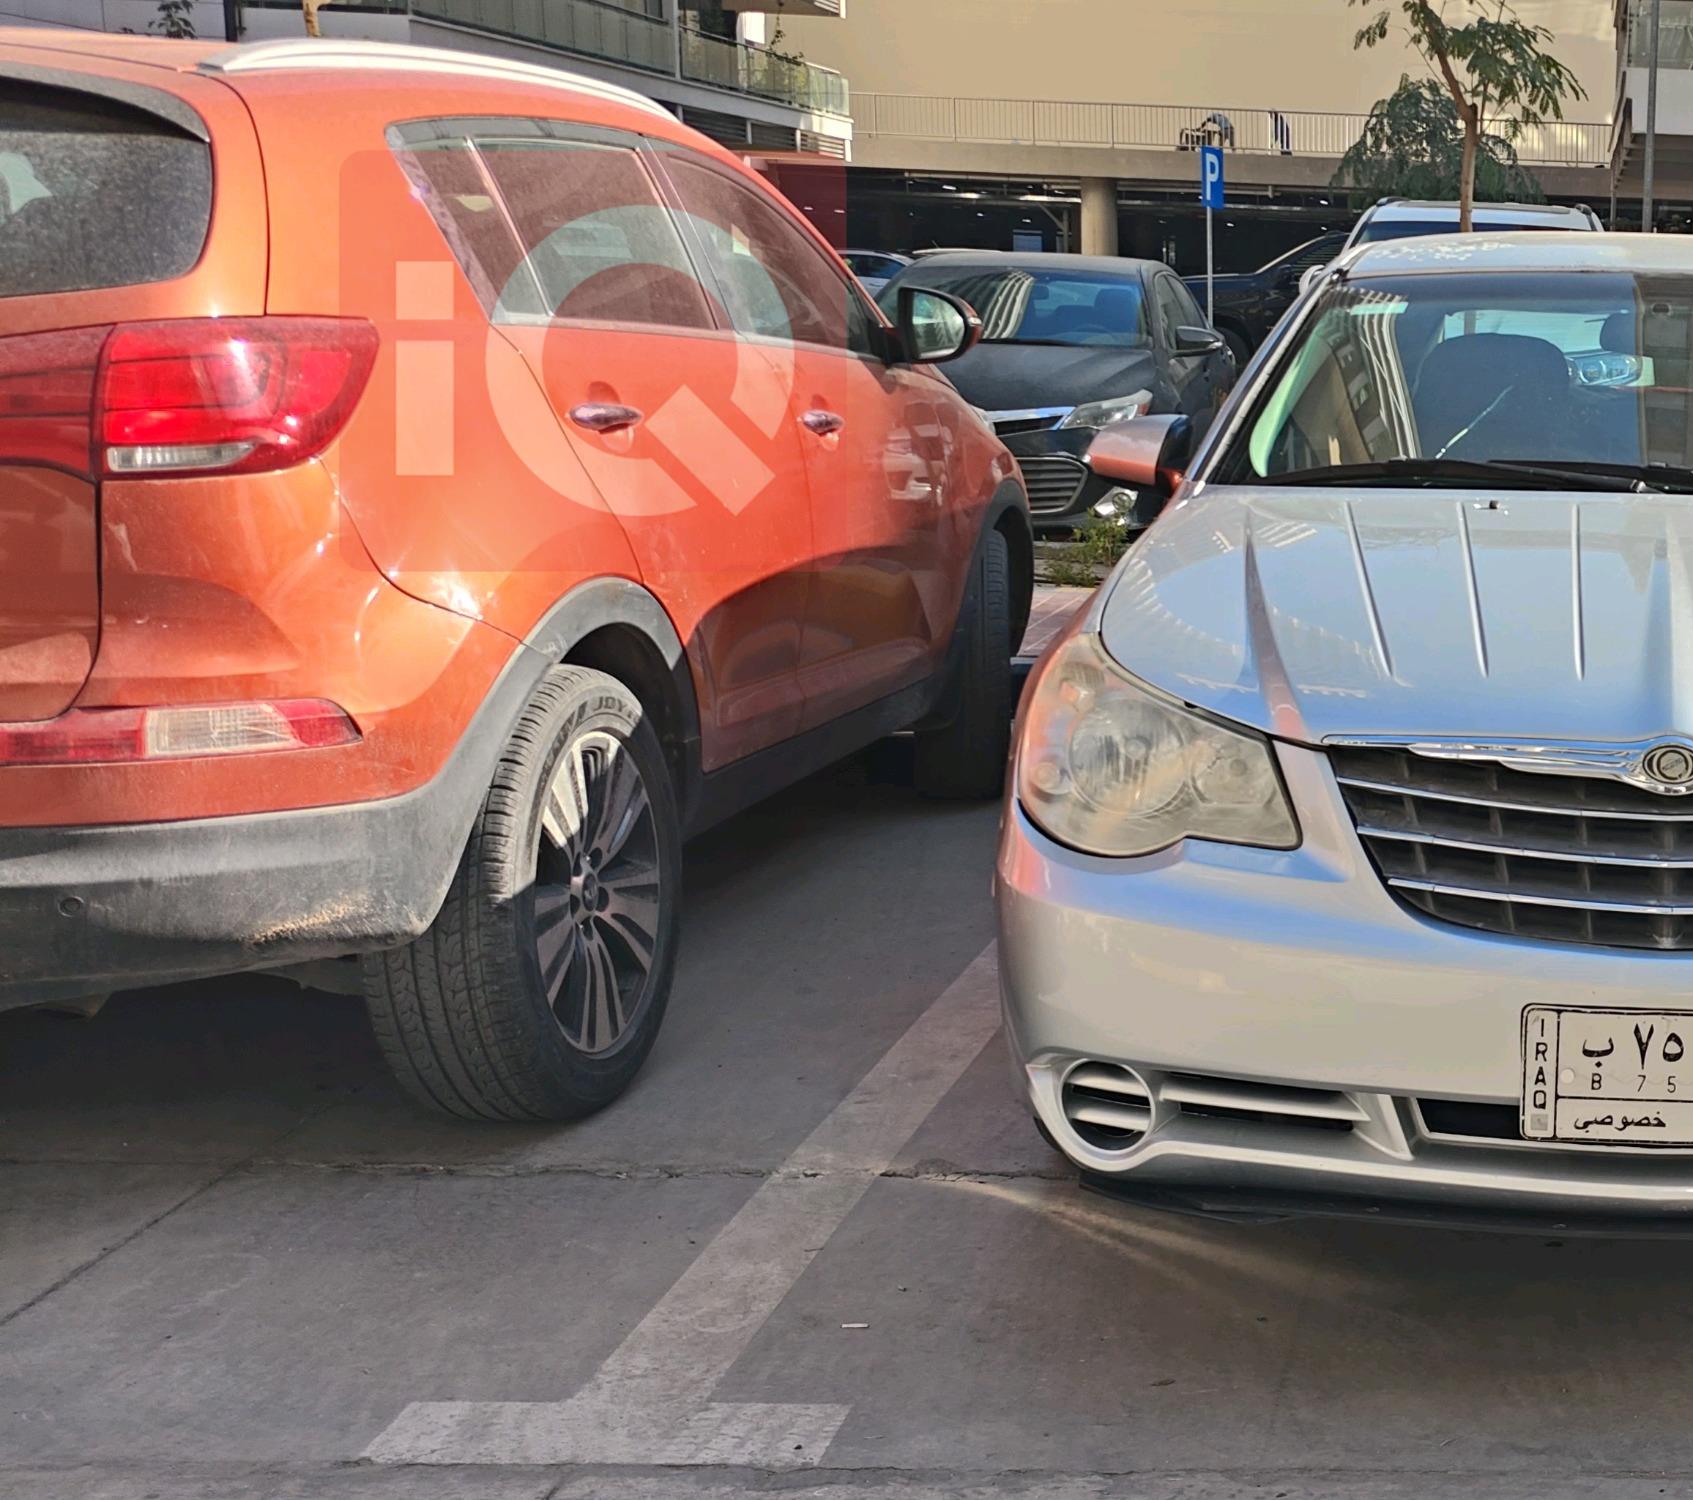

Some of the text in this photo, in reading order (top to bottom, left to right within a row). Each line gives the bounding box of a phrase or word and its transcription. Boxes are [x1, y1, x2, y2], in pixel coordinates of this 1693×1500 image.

[1205, 152, 1220, 201] P
[1533, 1018, 1549, 1110] IRAQ
[1581, 1036, 1615, 1069] ب
[1590, 1072, 1603, 1091] B
[1573, 1111, 1667, 1133] خصوصي
